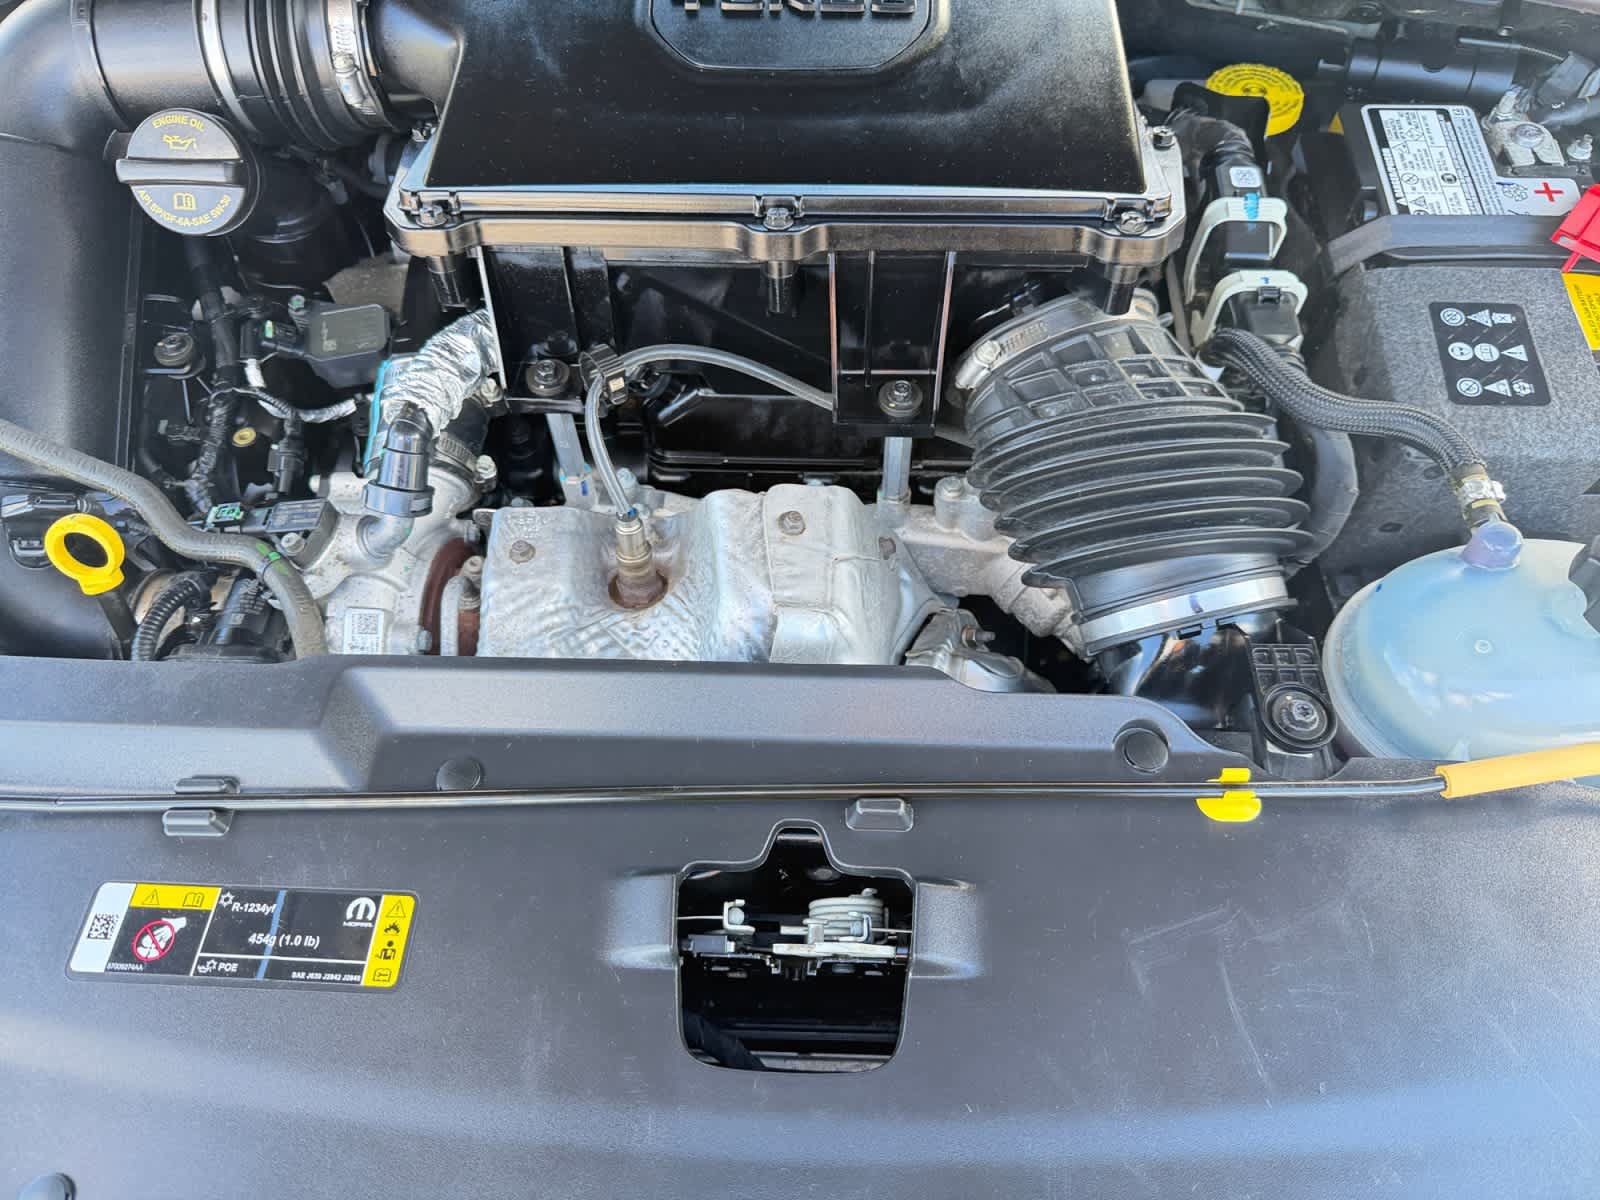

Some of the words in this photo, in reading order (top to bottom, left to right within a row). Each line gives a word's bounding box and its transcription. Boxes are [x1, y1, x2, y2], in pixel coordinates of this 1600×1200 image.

[152, 115, 189, 128] ENGINE
[190, 118, 204, 132] OIL
[137, 190, 153, 206] API
[231, 902, 277, 916] R-1234yf
[248, 933, 277, 948] 454g
[279, 933, 303, 948] (1.0
[303, 935, 320, 950] lb)
[217, 962, 239, 973] POE
